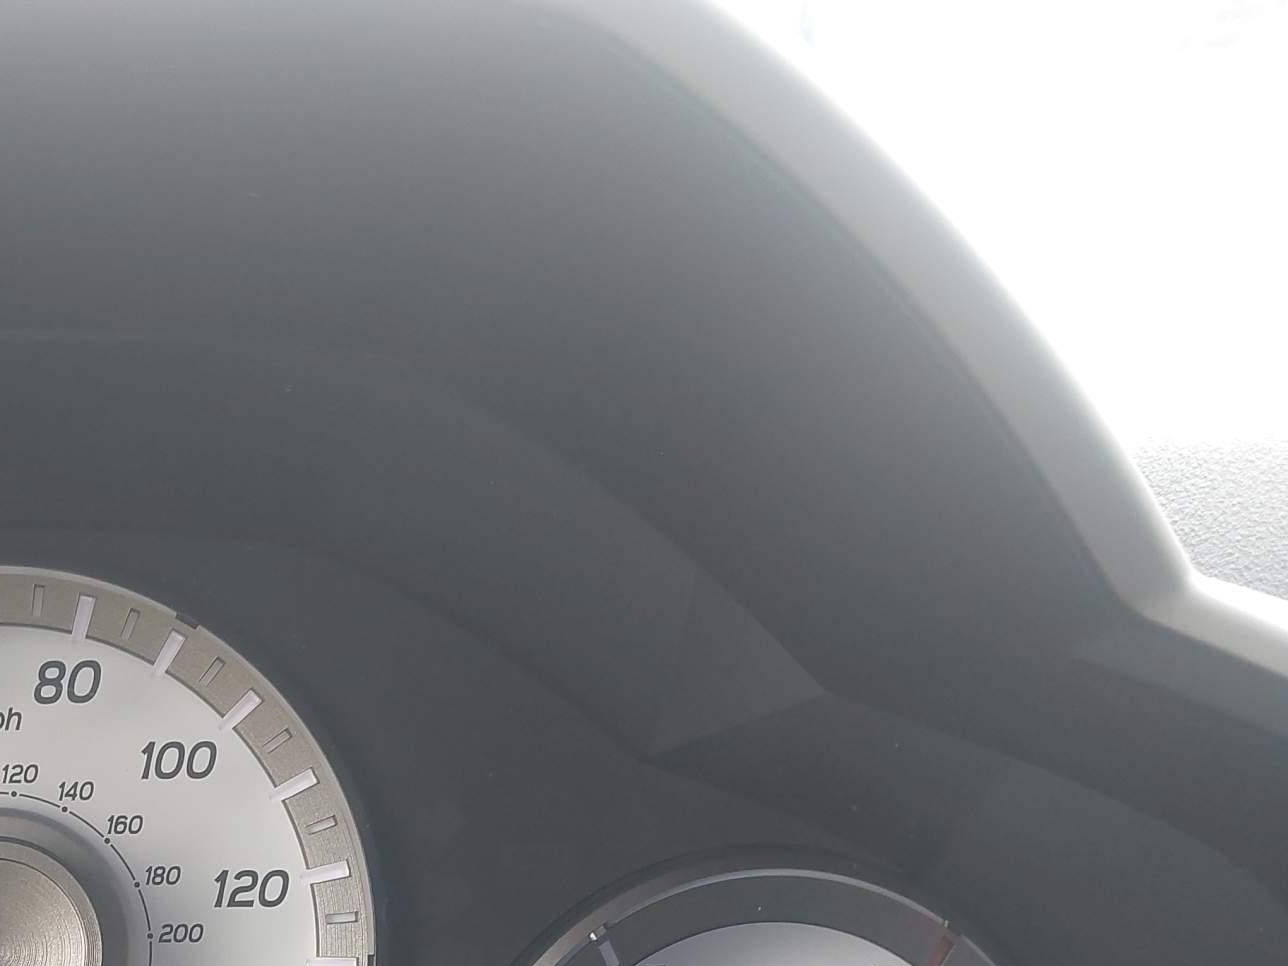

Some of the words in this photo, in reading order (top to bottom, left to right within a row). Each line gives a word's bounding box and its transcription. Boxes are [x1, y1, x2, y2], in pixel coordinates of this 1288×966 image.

[33, 660, 102, 704] 80
[140, 740, 218, 780] 100
[1, 764, 39, 784] 120
[58, 781, 95, 801] 140
[107, 814, 144, 835] 160
[144, 866, 181, 886] 180
[213, 869, 290, 908] 120
[158, 923, 204, 943] 200
